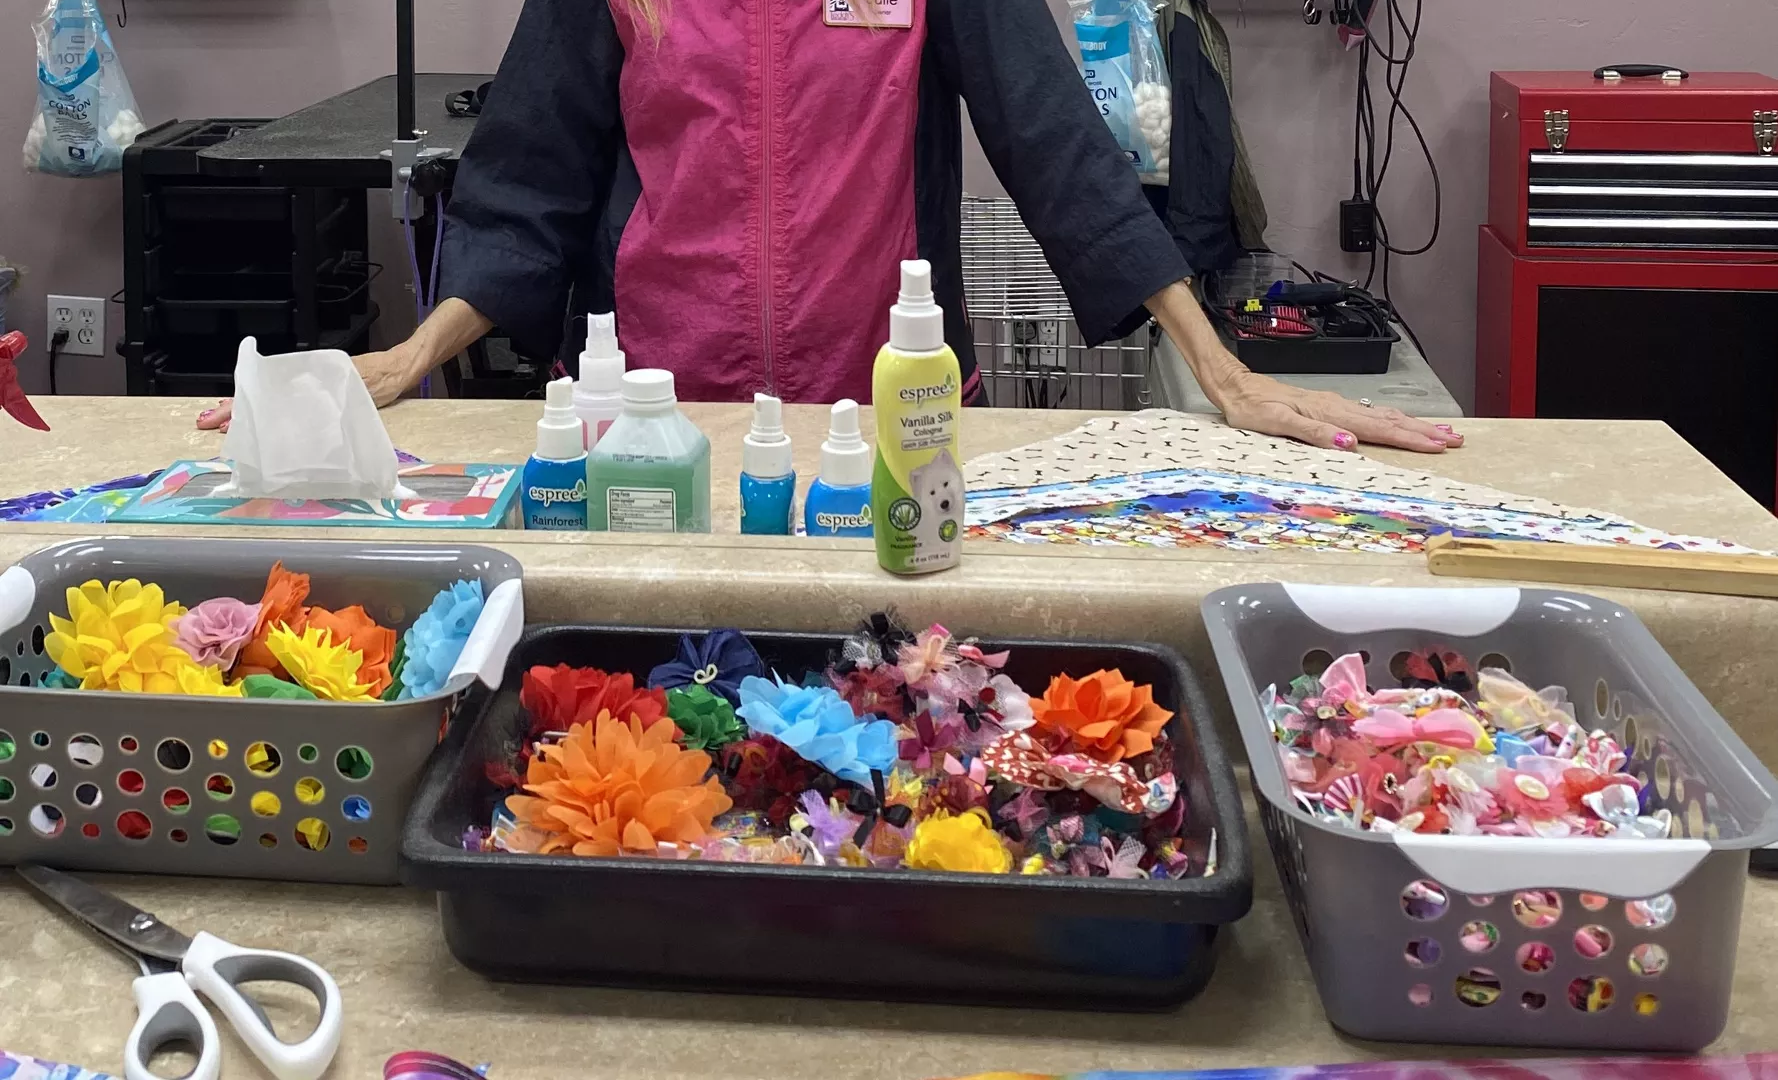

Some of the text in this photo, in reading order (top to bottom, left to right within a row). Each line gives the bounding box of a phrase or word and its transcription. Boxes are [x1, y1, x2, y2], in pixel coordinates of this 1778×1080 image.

[49, 99, 91, 113] COTTON
[900, 383, 948, 404] espree
[900, 411, 953, 428] Vanilla Silk
[913, 427, 943, 436] Cologne
[530, 488, 579, 505] espree
[532, 515, 584, 526] Rainforest
[817, 514, 865, 531] espree
